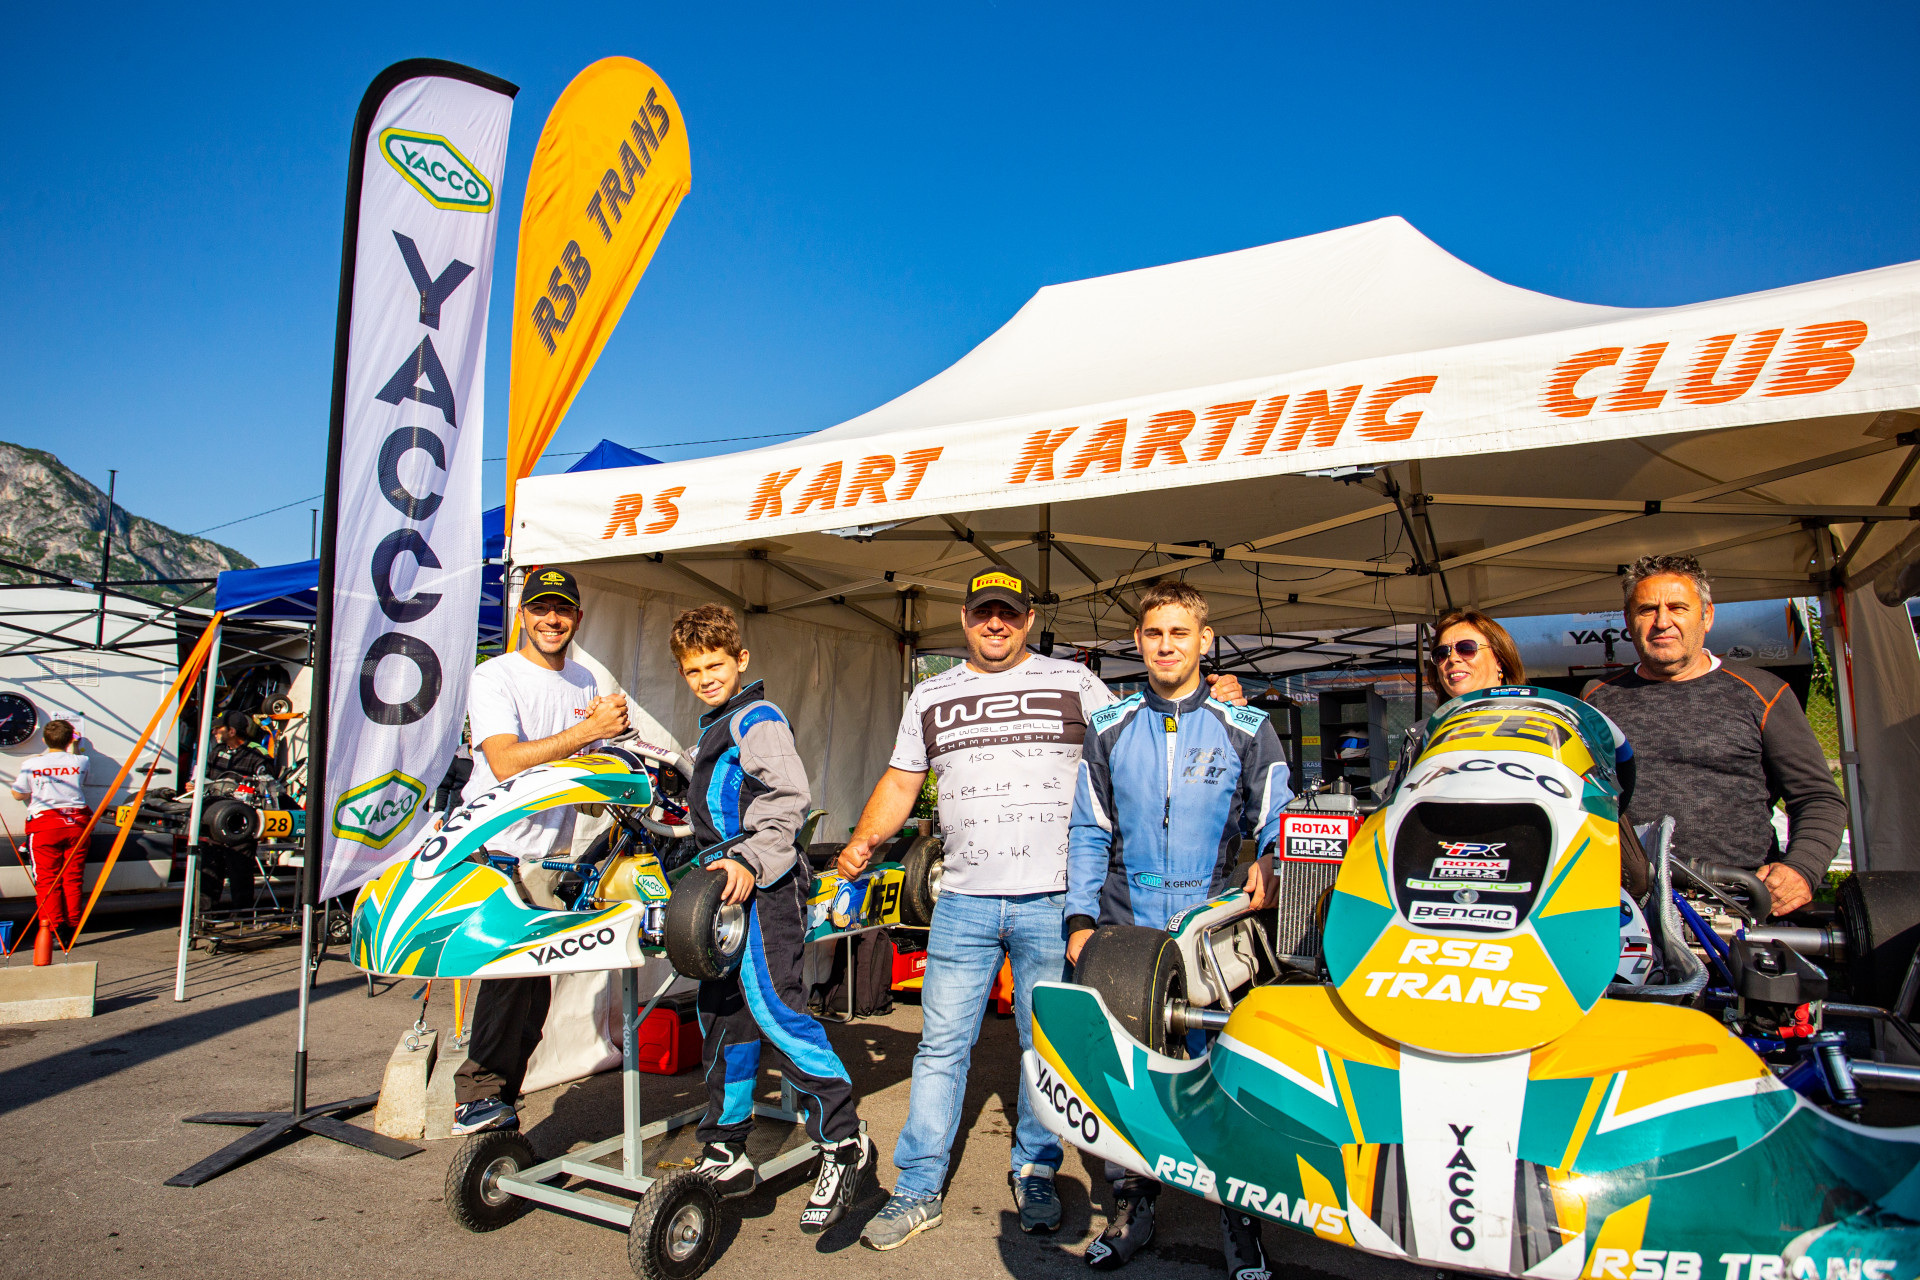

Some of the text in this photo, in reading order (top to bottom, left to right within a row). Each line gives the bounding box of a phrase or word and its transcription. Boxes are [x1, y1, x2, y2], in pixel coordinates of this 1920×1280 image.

[399, 143, 480, 200] YACCO
[530, 86, 671, 358] RSB TRANS
[601, 319, 1868, 540] RS KART KARTING CLUB
[359, 229, 475, 726] YACCO
[1568, 628, 1633, 645] YACC
[935, 692, 1062, 728] WRC
[1096, 712, 1117, 723] OMP
[1236, 712, 1259, 724] OMP
[940, 735, 1061, 752] CHAMPIONSHIP
[32, 766, 80, 778] ROTAX
[1403, 758, 1573, 799] YACCO
[266, 817, 288, 832] 28
[348, 794, 413, 827] YACCO
[1292, 822, 1342, 835] ROTAX
[1291, 838, 1342, 852] MAX
[1291, 849, 1343, 857] CHALLENGE
[1442, 860, 1501, 868] ROTAX
[641, 877, 664, 895] YACCO
[1414, 906, 1512, 921] BENGIO
[528, 927, 615, 966] YACCO
[1398, 938, 1514, 972] RSB
[1364, 972, 1548, 1012] TRANS
[622, 1013, 631, 1058] YACCO
[1035, 1058, 1100, 1144] YACCO
[1155, 1154, 1349, 1236] RSB TRANS
[1445, 1123, 1476, 1251] YACCO
[801, 1211, 829, 1222] OMP
[1590, 1248, 1898, 1280] RSB TRANS
